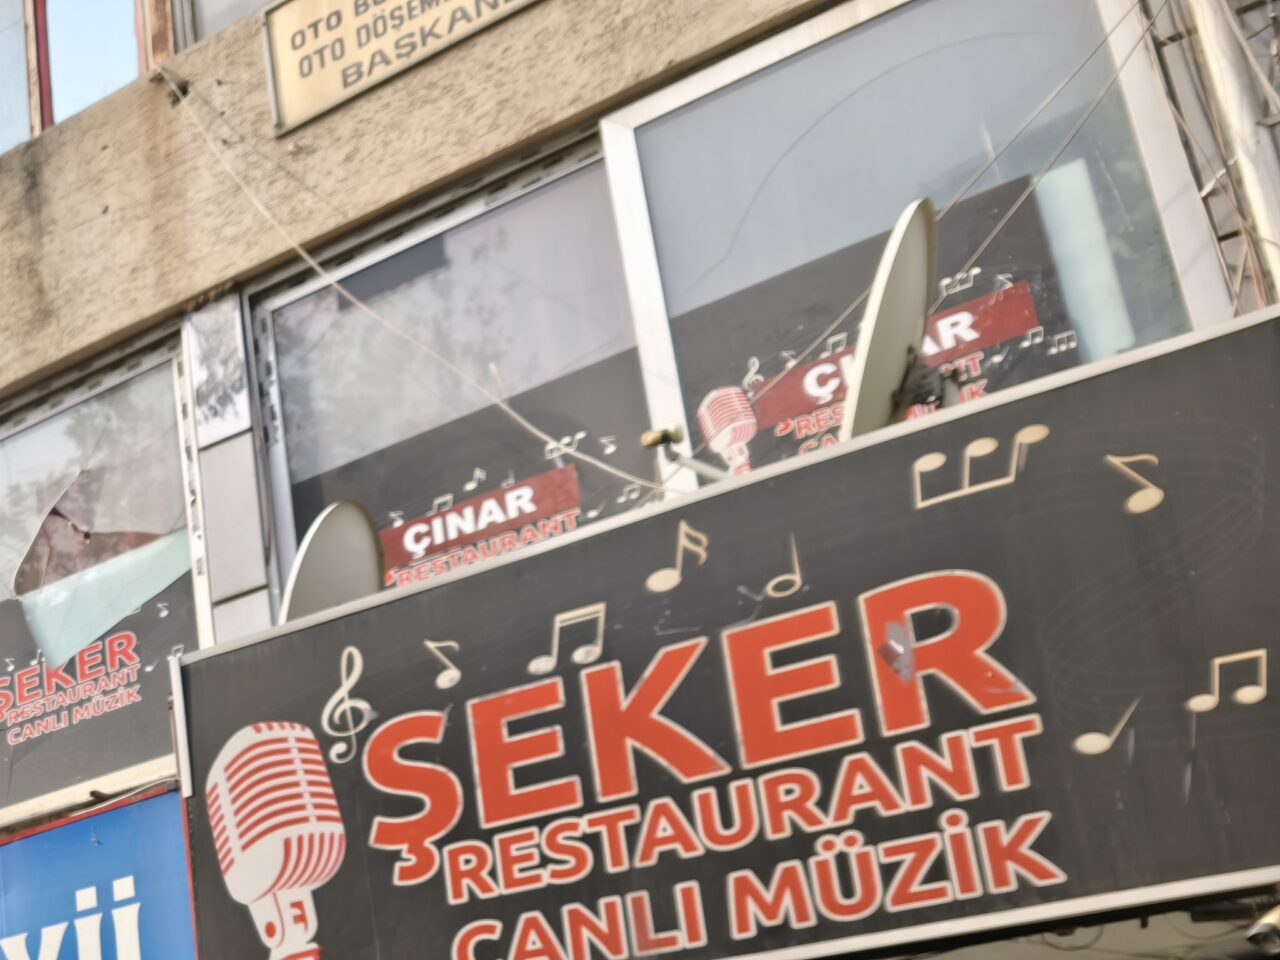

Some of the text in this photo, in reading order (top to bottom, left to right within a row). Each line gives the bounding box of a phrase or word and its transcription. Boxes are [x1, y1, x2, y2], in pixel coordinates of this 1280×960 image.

[291, 9, 342, 50] OTO
[298, 37, 345, 79] OTO
[341, 0, 512, 89] BAŞKAN
[397, 507, 581, 586] RESTAURANT
[403, 485, 537, 559] ÇINAR
[7, 663, 141, 727] RESTAURANT
[7, 685, 142, 746] CANLI MÜZİK
[363, 568, 1038, 887] ŞEKER
[444, 713, 1042, 906] RESTAURANT
[729, 808, 1067, 940] MÜZİK
